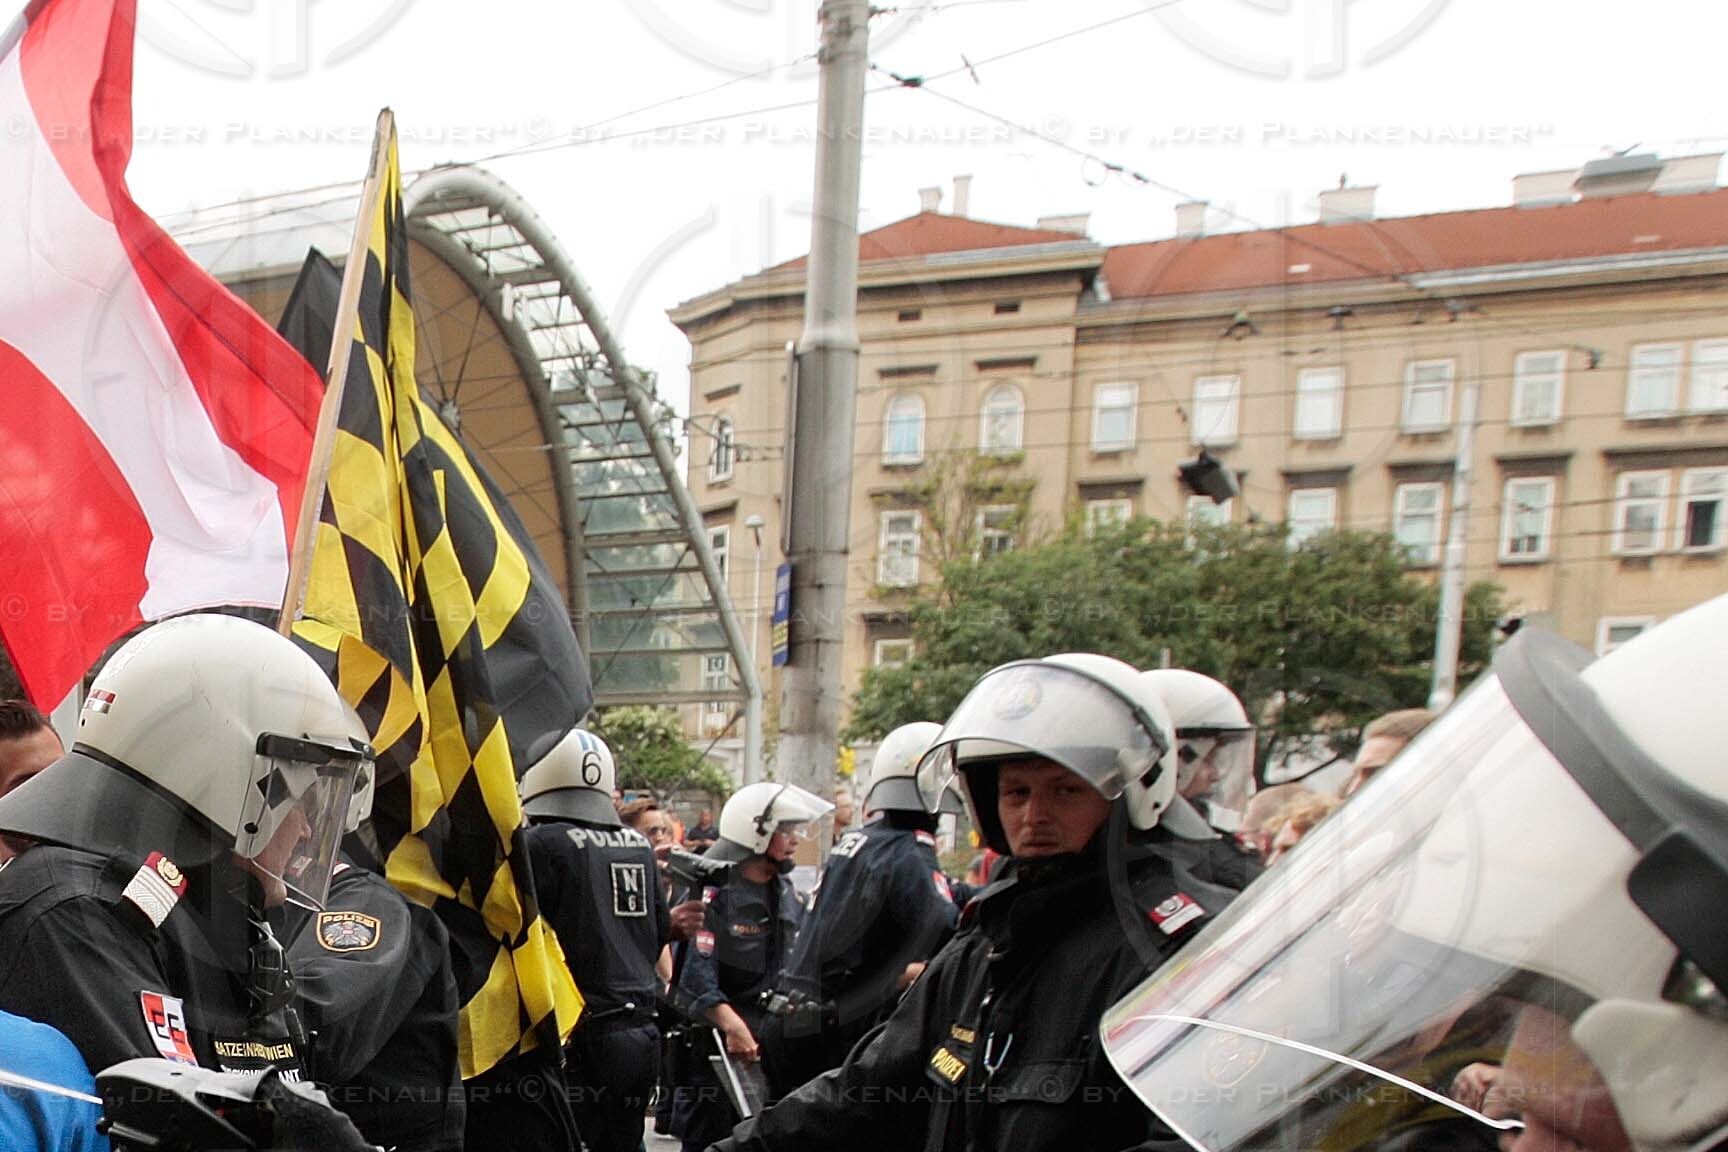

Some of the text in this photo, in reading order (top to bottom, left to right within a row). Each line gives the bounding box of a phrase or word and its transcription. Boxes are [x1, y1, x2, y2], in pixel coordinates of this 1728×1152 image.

[582, 751, 602, 786] 6
[566, 828, 651, 849] POLIZE
[623, 868, 638, 892] N
[323, 914, 375, 928] POLIZEI
